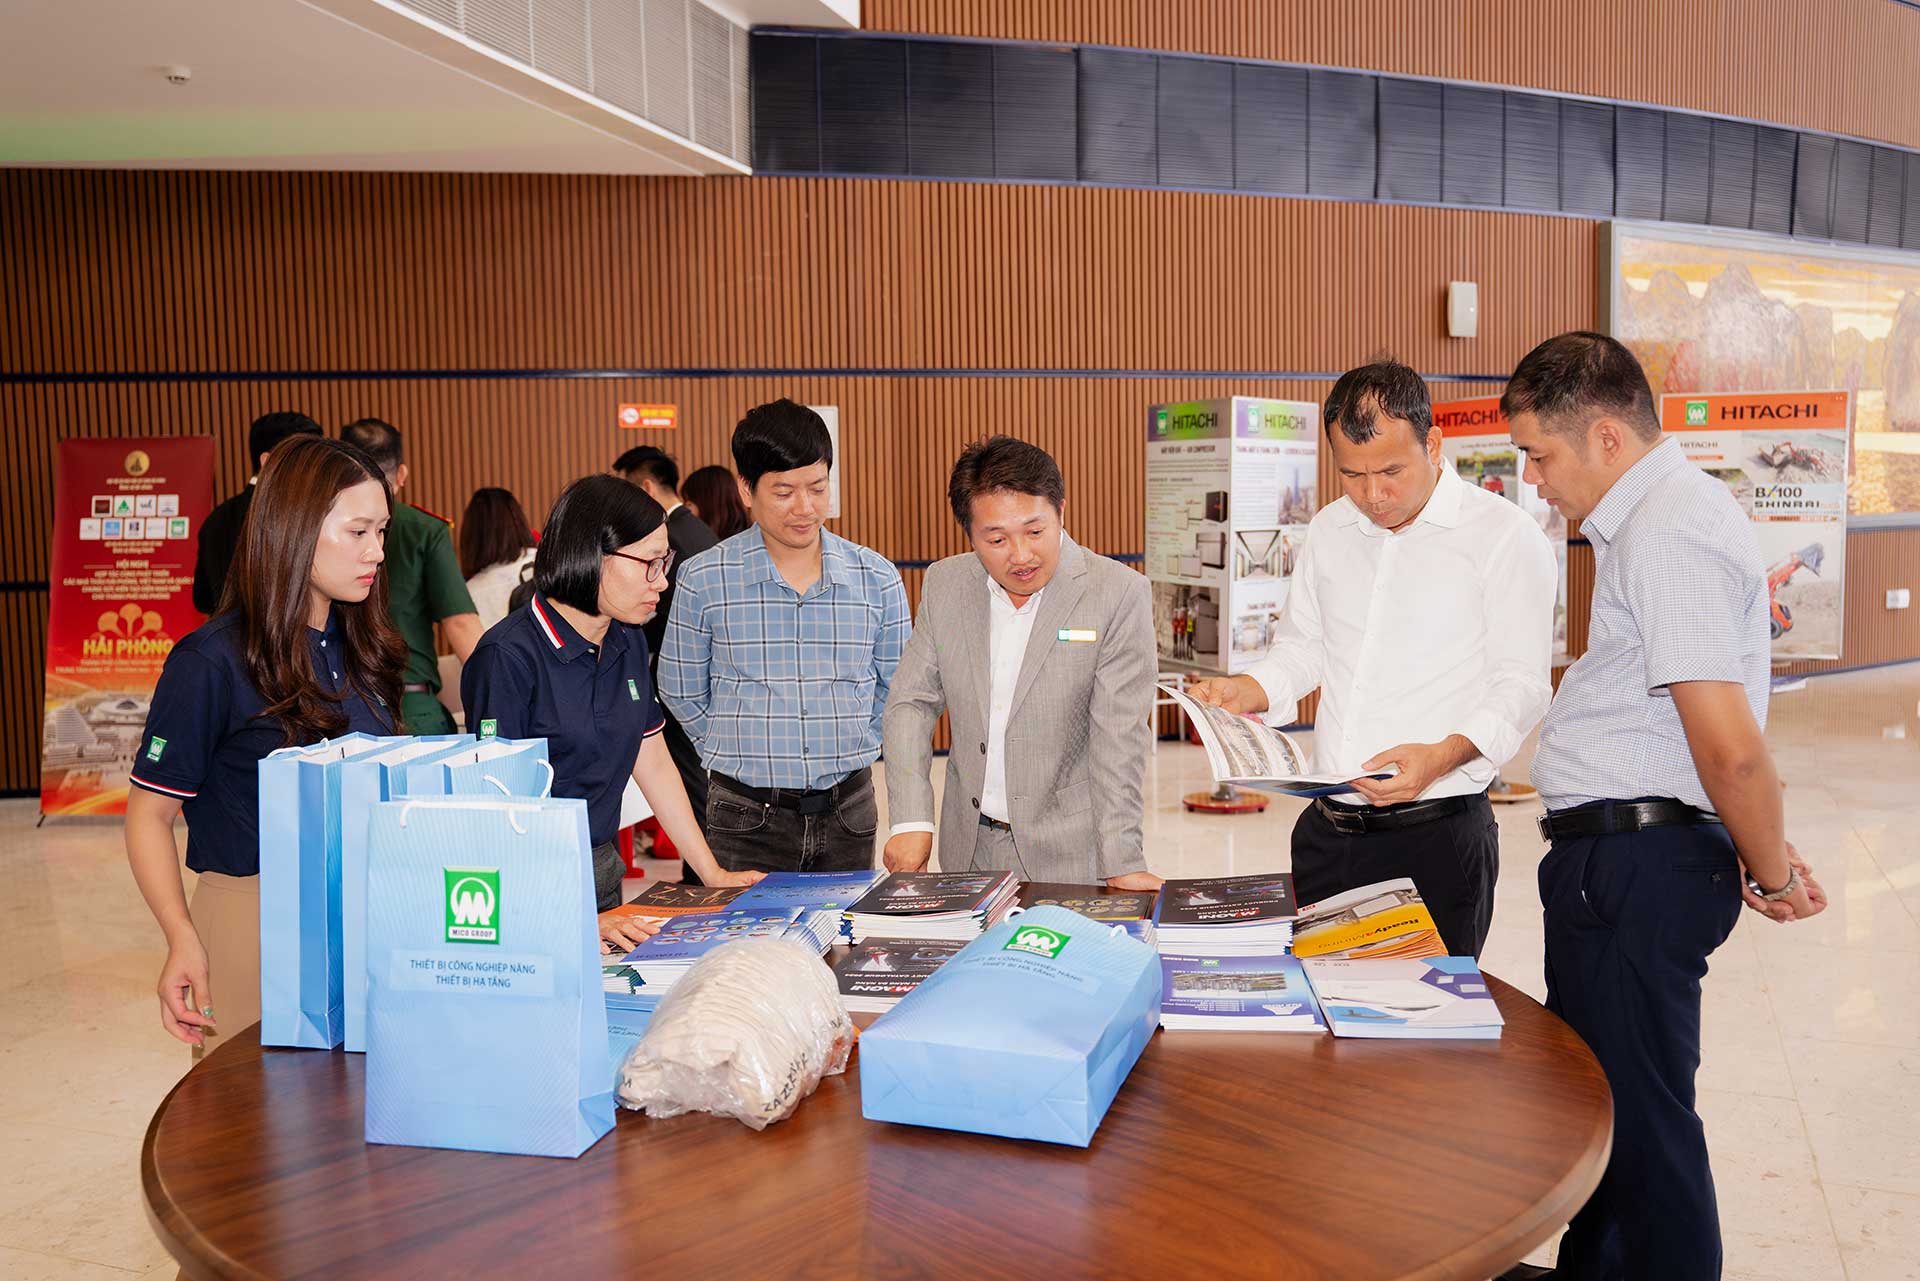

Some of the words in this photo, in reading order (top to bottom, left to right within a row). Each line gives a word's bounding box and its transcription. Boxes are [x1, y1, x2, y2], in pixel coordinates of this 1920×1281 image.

[1435, 409, 1498, 427] HITACHI
[1721, 404, 1818, 420] HITACHI
[1172, 412, 1218, 430] HITACHI
[1264, 413, 1307, 430] HITACHI
[1754, 500, 1820, 508] SHINRAI
[83, 636, 113, 656] HẢI
[116, 636, 174, 656] PHÒNG
[1198, 910, 1256, 920] MAGNI
[410, 958, 434, 969] THIẾT
[448, 960, 473, 970] CÔNG
[436, 974, 460, 985] THIẾT
